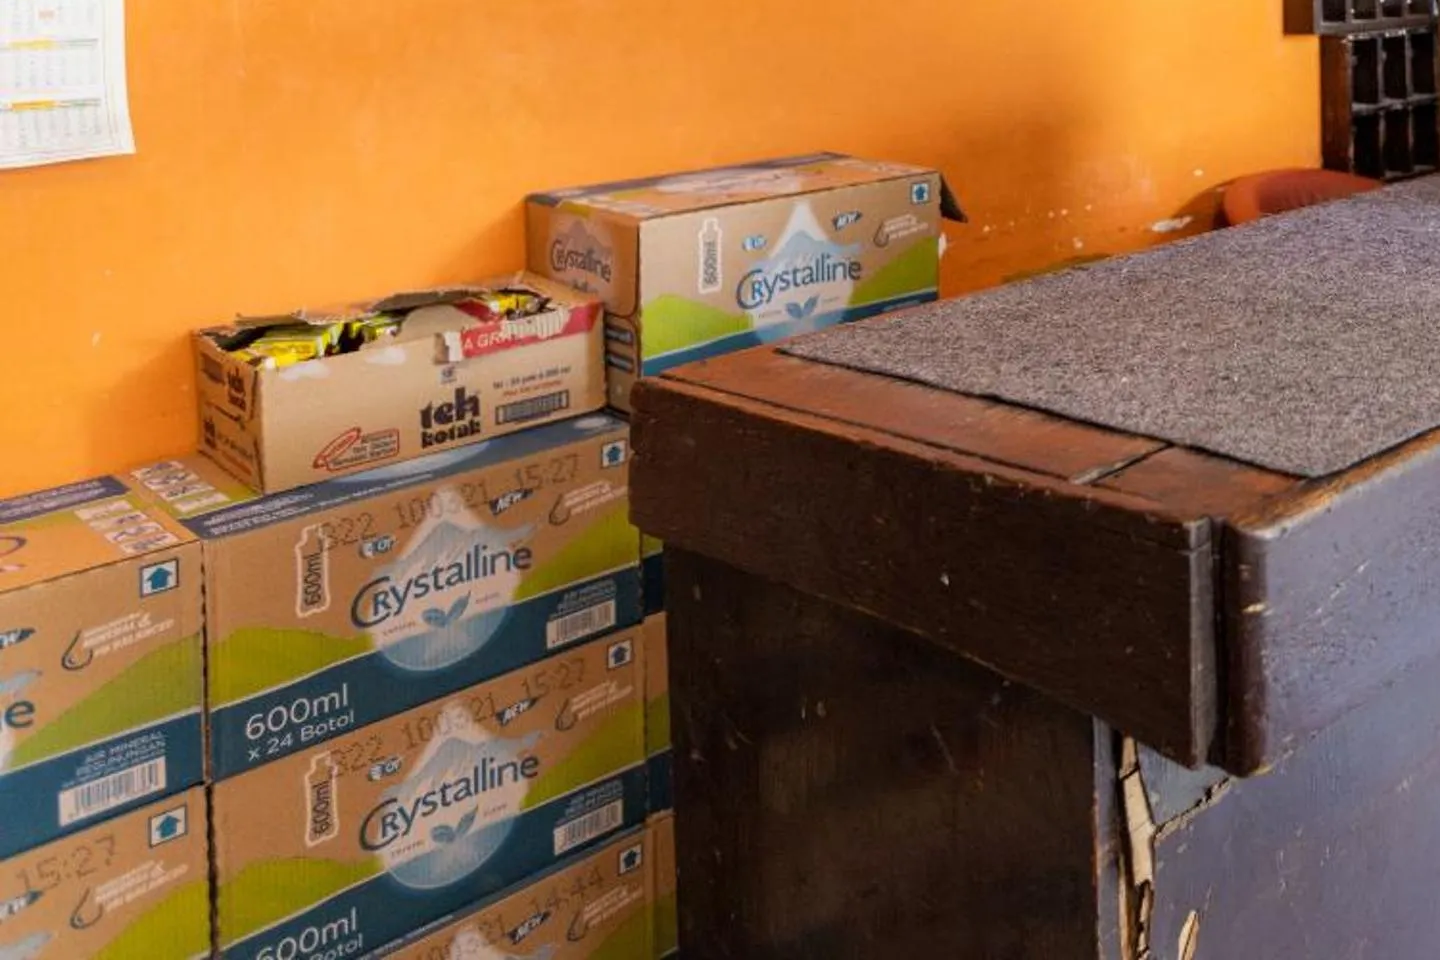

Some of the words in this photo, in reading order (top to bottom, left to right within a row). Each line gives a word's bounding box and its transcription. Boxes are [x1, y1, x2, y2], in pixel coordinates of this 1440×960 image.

[245, 683, 349, 741] 600ml
[248, 747, 260, 762] x
[266, 732, 293, 756] 24
[300, 711, 355, 742] Botol
